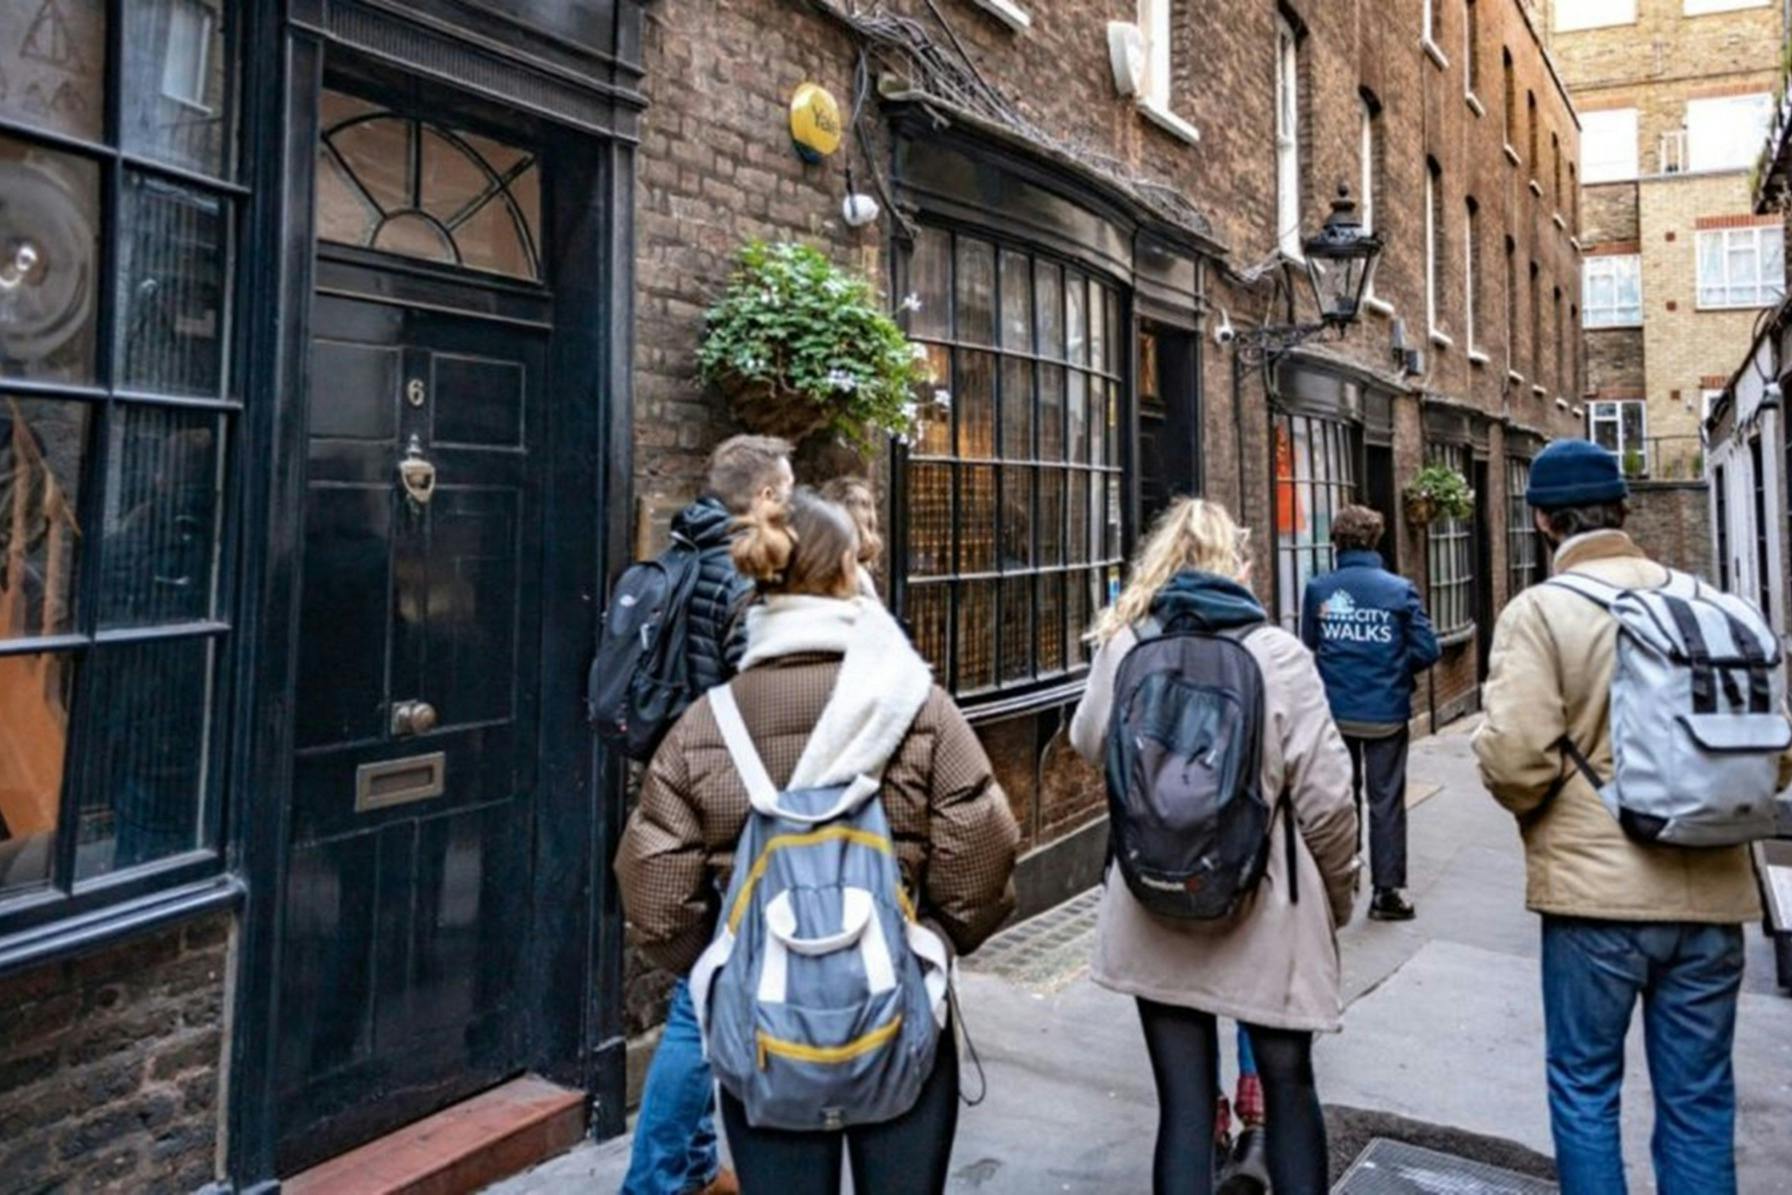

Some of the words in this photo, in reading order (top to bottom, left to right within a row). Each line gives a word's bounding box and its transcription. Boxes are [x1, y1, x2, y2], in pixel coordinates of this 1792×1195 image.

[408, 379, 425, 406] 6
[1354, 608, 1391, 623] CITY
[1321, 622, 1392, 643] WALKS
